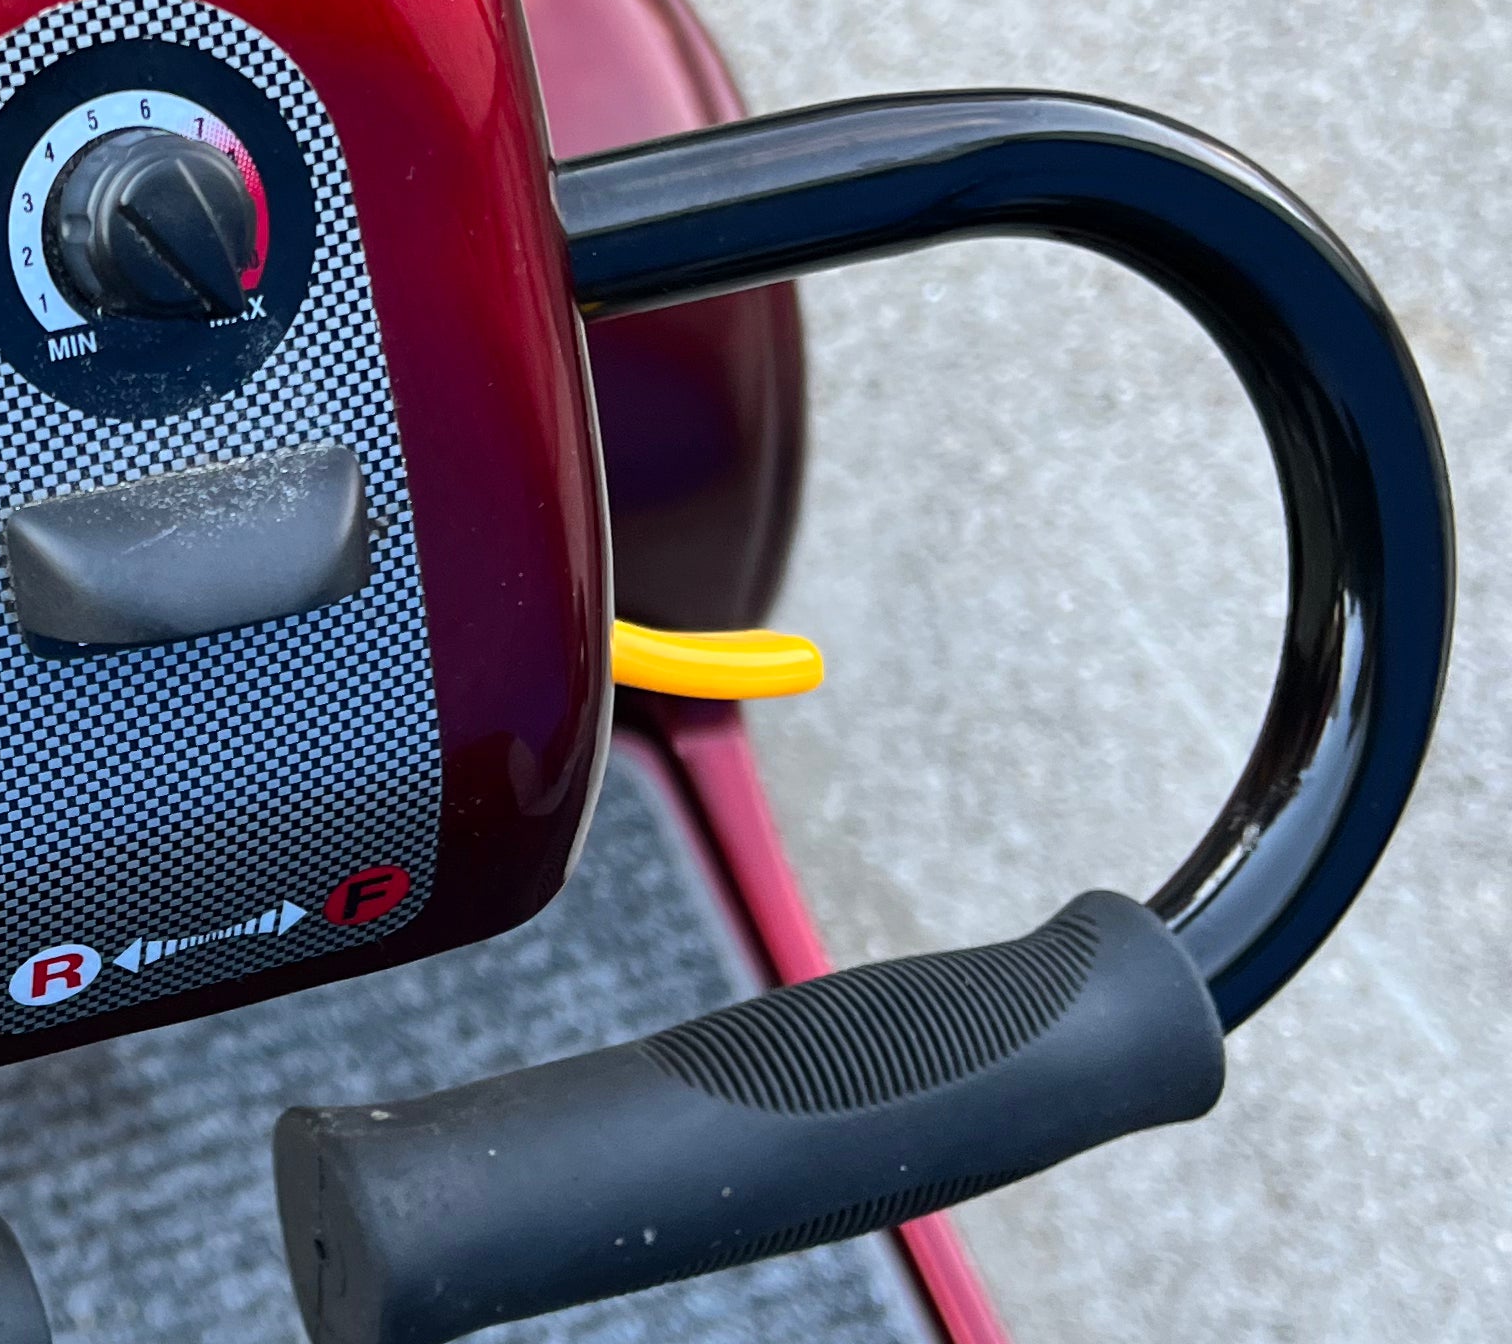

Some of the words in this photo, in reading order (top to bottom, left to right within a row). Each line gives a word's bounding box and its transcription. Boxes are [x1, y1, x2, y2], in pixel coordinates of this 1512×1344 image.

[139, 99, 151, 120] 6
[88, 110, 99, 131] 5
[193, 117, 204, 139] 7
[44, 142, 55, 162] 4
[22, 193, 34, 213] 3
[22, 246, 34, 267] 2
[39, 293, 49, 313] 1
[47, 331, 99, 362] MIN
[342, 874, 394, 920] F
[31, 953, 85, 999] R
